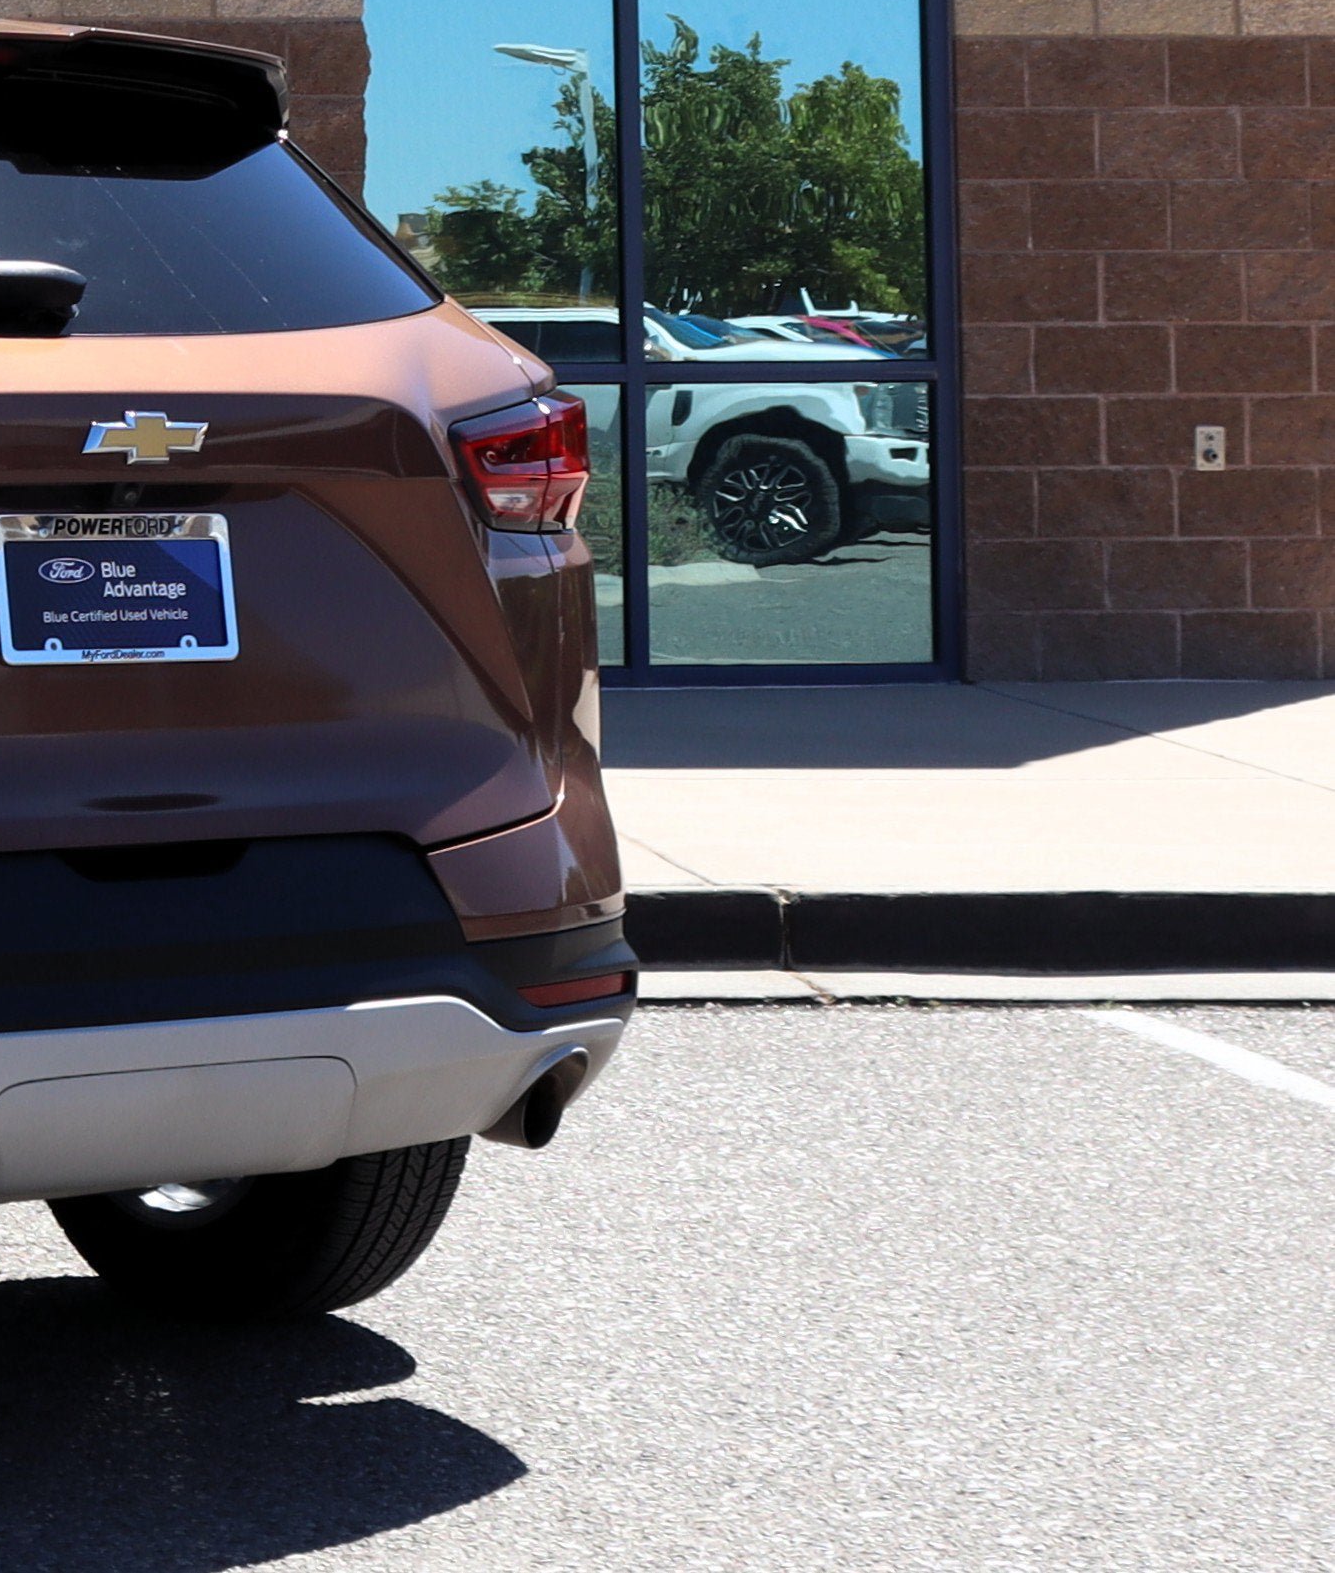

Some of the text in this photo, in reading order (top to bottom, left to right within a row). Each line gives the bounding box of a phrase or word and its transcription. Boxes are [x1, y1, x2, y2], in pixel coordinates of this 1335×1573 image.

[49, 561, 84, 579] Ford
[101, 561, 136, 578] Blue
[103, 581, 187, 599] Advantage
[43, 607, 189, 623] Blue Certified Used Vehicle
